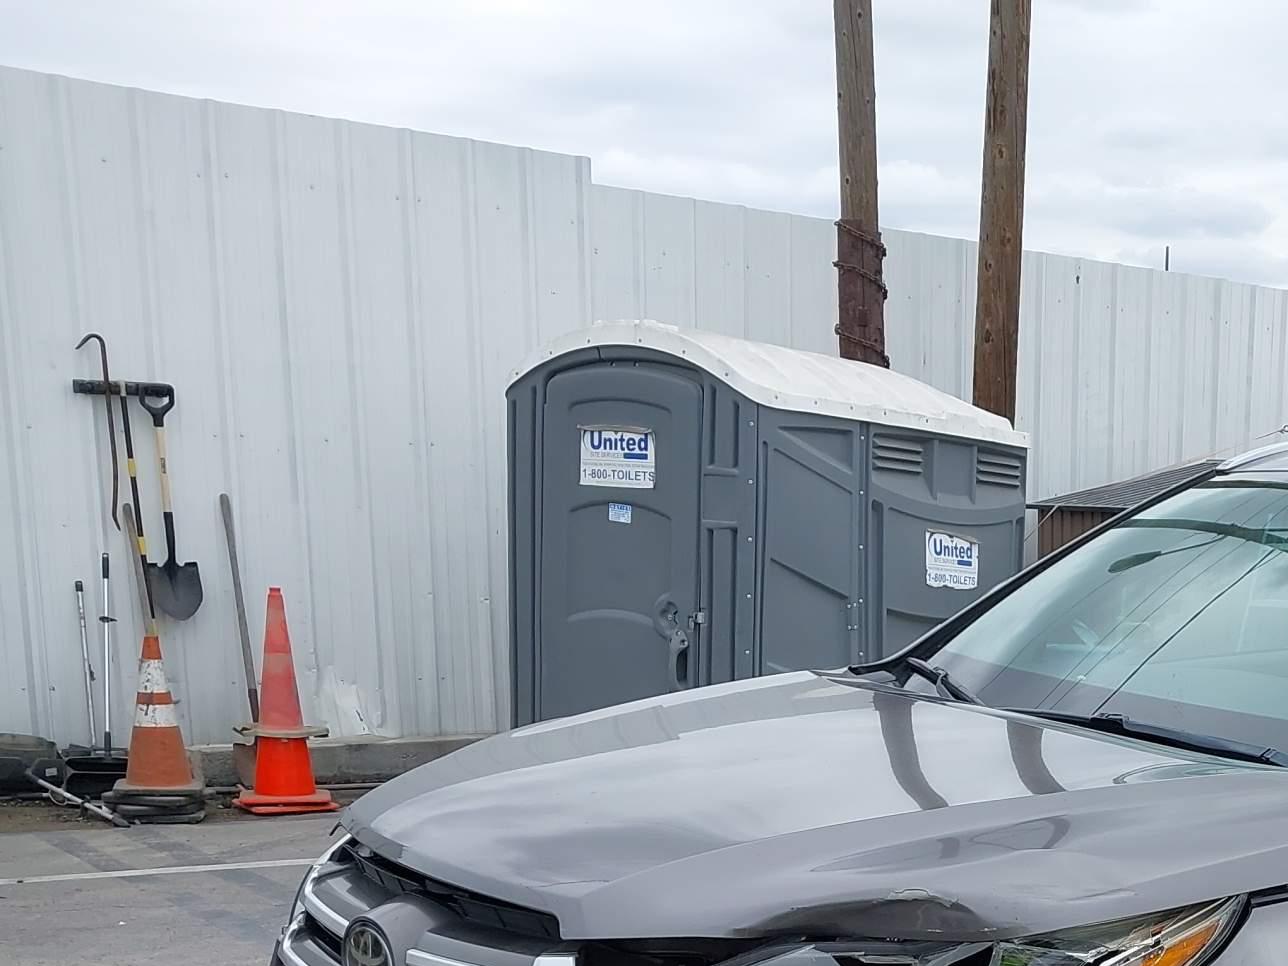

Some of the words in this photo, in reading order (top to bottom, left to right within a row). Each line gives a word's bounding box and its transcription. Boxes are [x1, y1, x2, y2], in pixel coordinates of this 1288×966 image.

[591, 431, 648, 451] United
[583, 469, 656, 481] 1-800-TOILETS
[933, 538, 973, 558] United
[928, 573, 976, 585] 1-800-TOILETS
